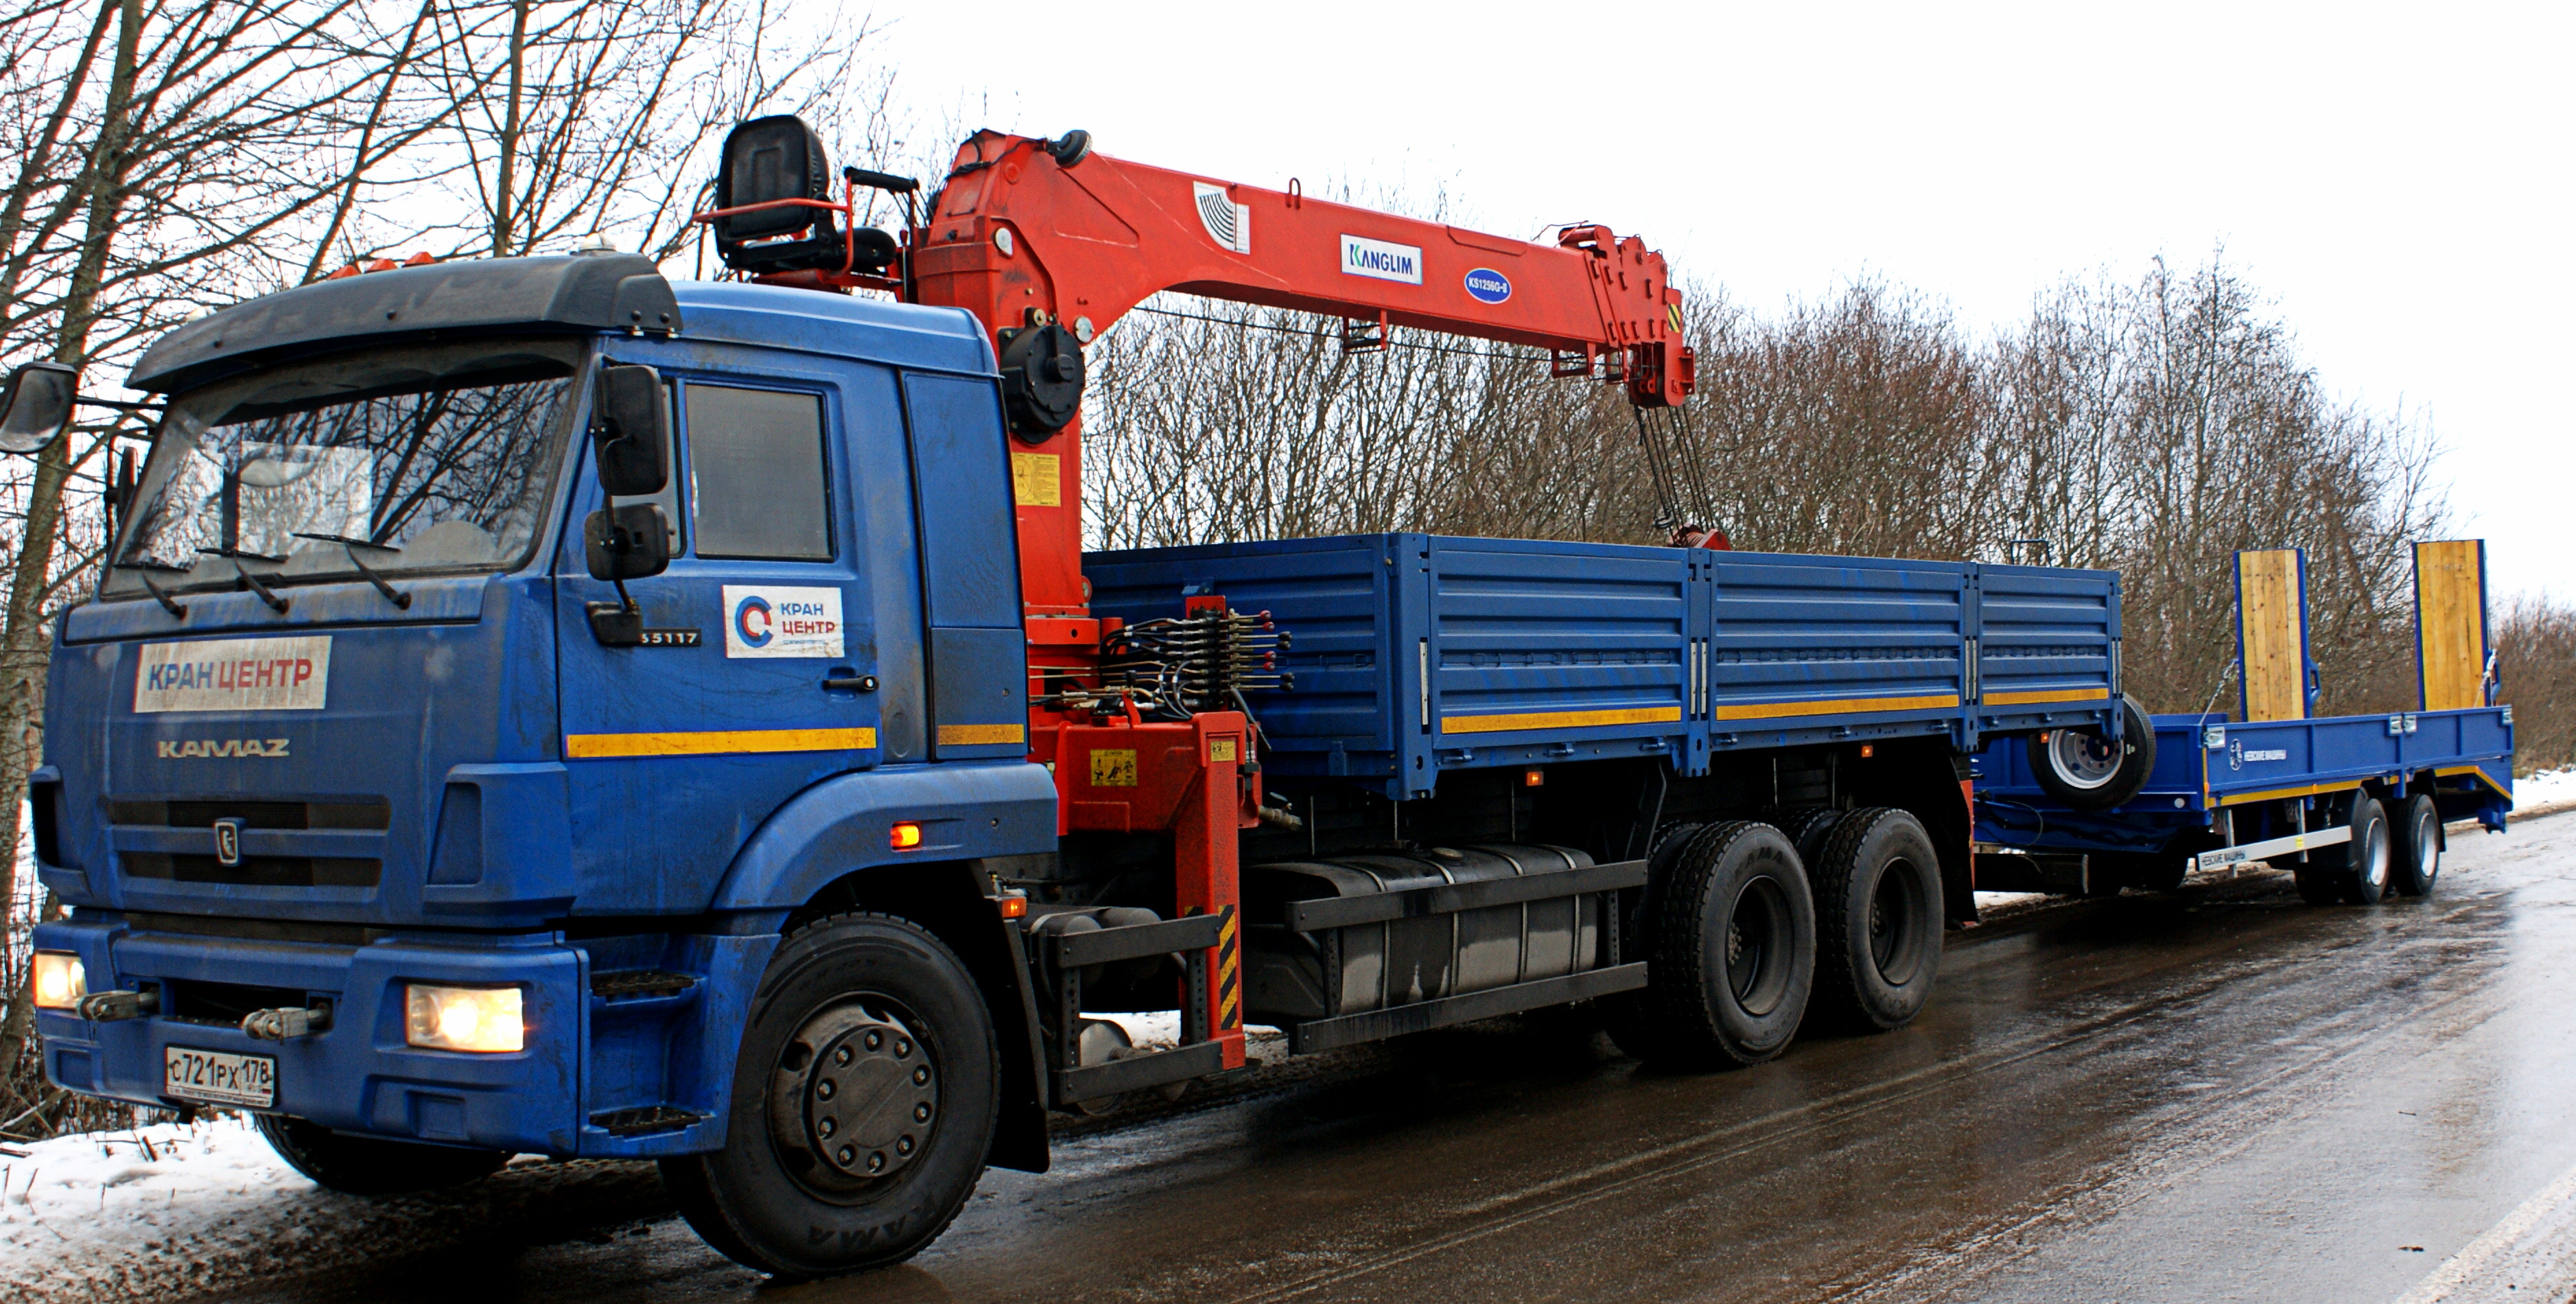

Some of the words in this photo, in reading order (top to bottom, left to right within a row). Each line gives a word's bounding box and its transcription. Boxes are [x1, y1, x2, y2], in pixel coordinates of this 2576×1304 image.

[1350, 243, 1413, 275] KANGLIM
[780, 603, 824, 616] КРАН
[782, 620, 836, 636] ЦЕНТР
[148, 662, 214, 690] КРАН
[218, 658, 313, 693] ЦЕНТР
[157, 738, 290, 758] KAMAZ
[242, 1059, 270, 1084] 178
